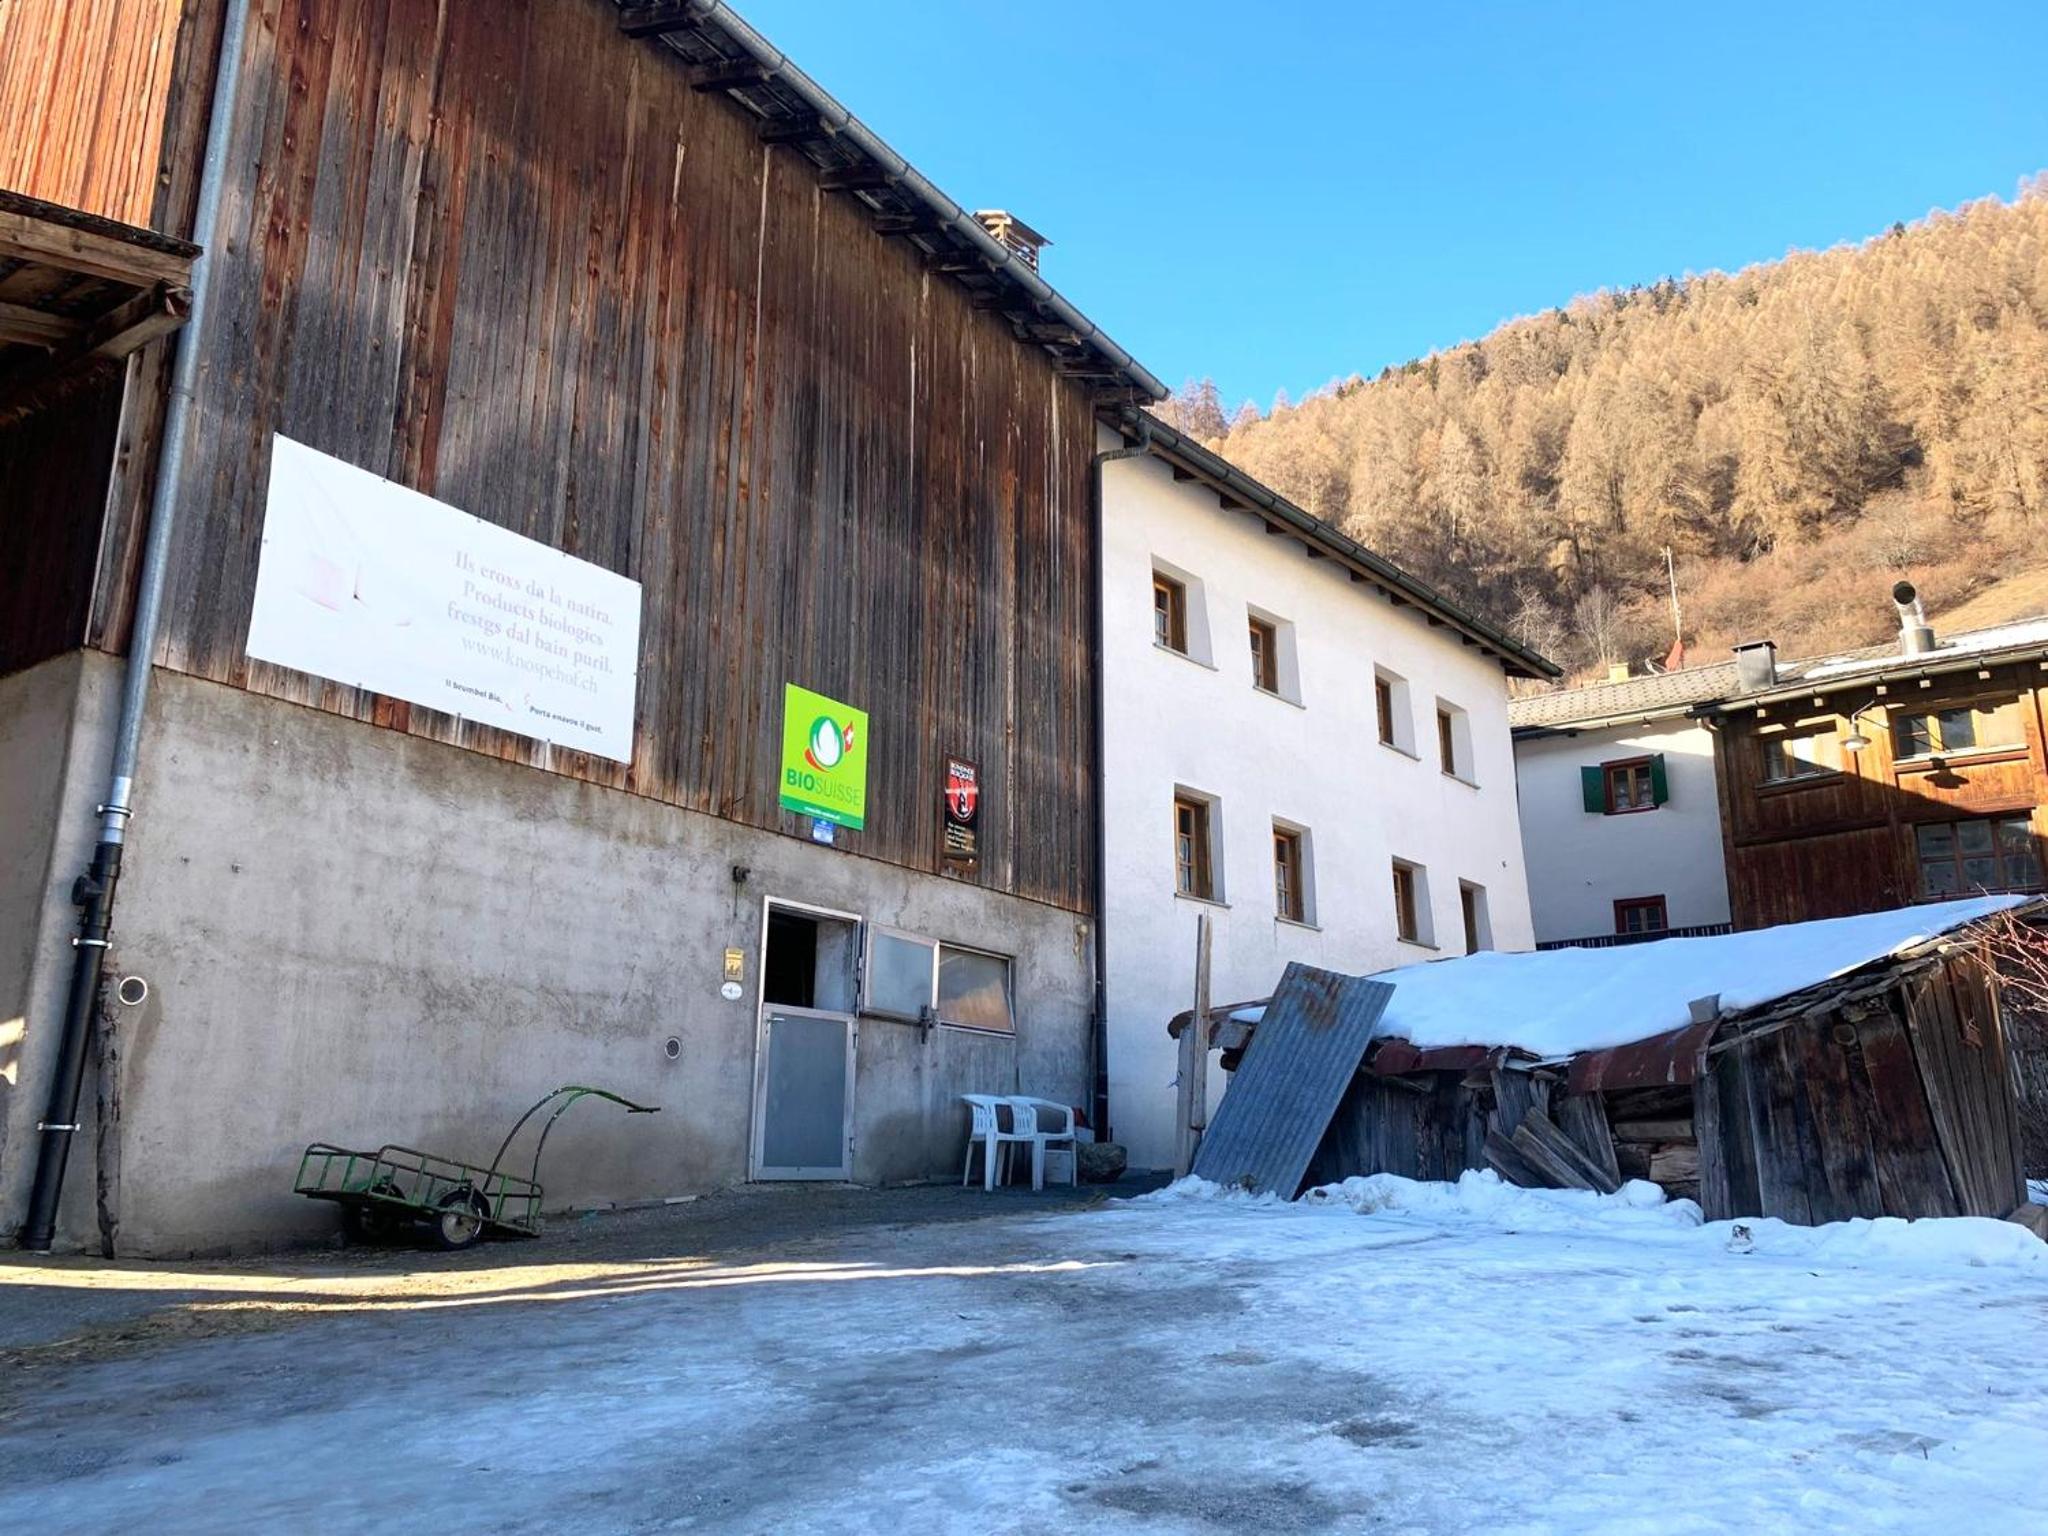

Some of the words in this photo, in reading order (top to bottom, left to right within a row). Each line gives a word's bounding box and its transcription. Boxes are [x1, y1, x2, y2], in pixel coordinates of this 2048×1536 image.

[455, 549, 475, 573] Ils
[525, 579, 545, 600] da
[448, 600, 502, 637] frestgs
[506, 621, 530, 645] dal
[535, 631, 568, 659] bain
[573, 651, 614, 675] puril.
[463, 578, 536, 622] Products
[539, 606, 605, 646] biologics
[461, 636, 598, 694] www.knospehof.ch
[529, 705, 551, 719] Porta
